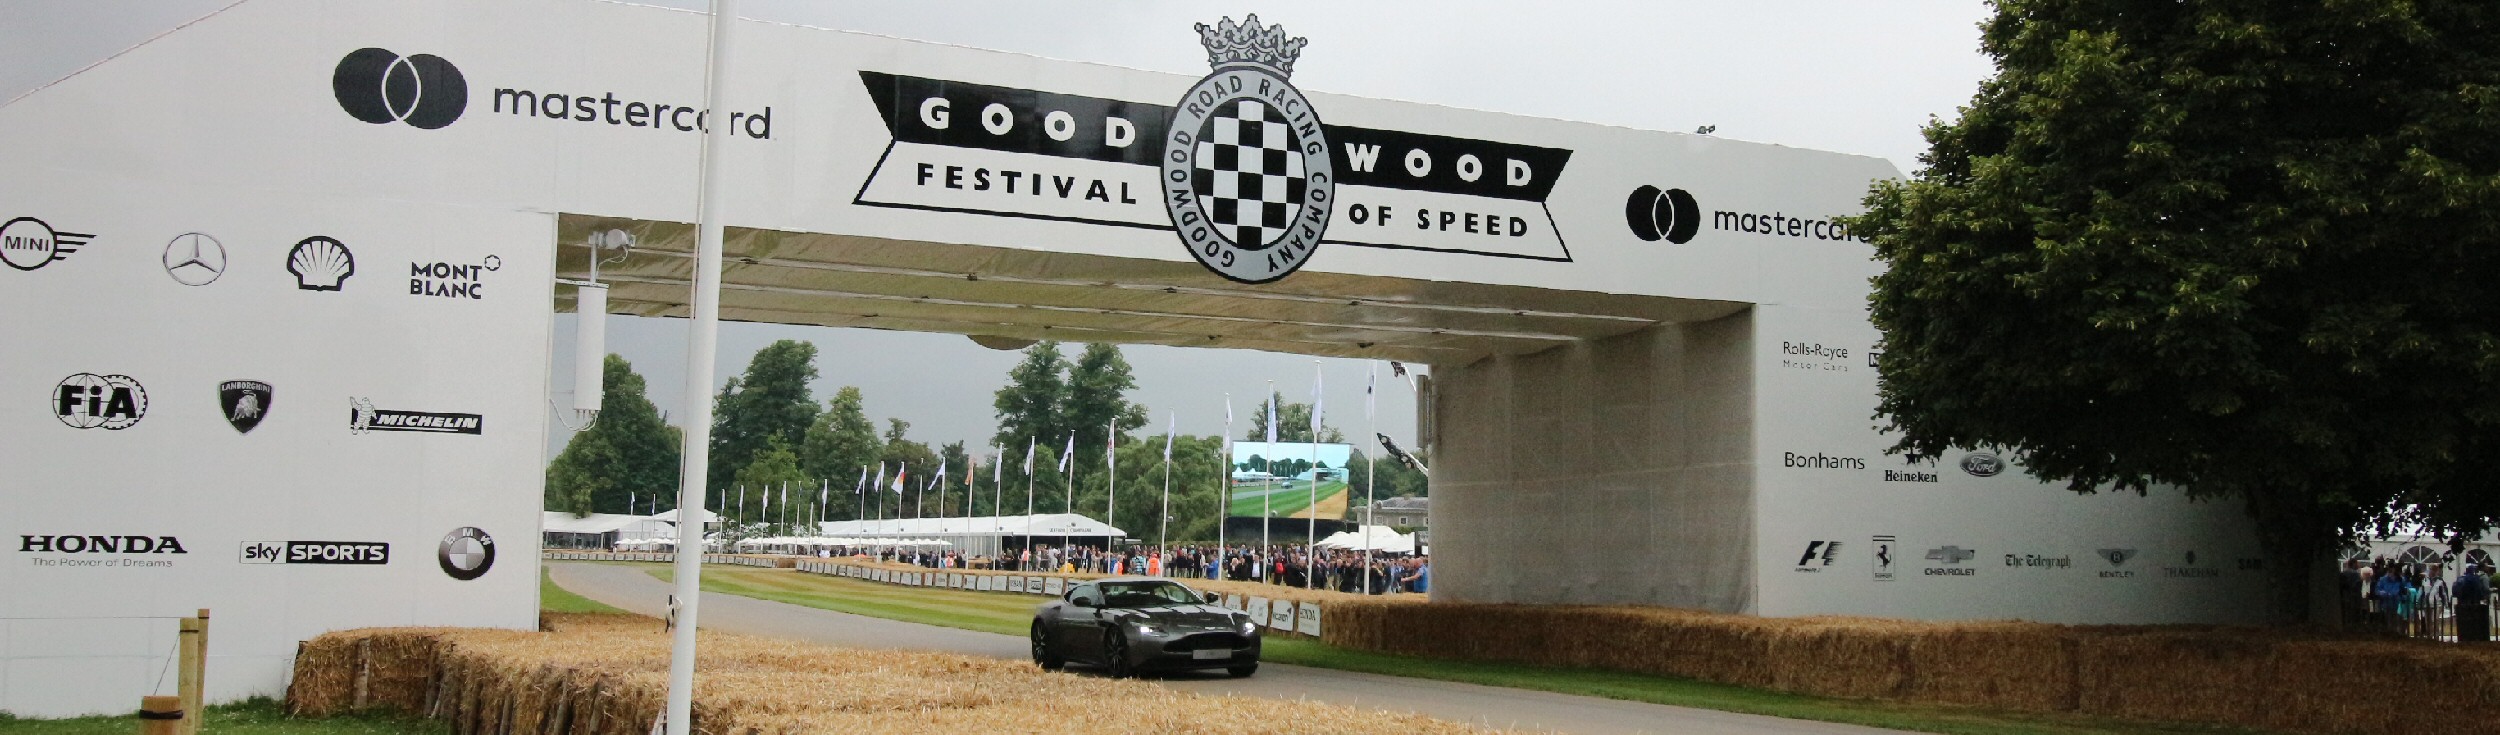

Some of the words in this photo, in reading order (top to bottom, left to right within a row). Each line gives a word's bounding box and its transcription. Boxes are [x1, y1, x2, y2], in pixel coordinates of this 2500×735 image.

[1187, 75, 1243, 119] ROAD
[1259, 78, 1323, 156] RACING
[919, 96, 1136, 148] GOOD
[1344, 142, 1532, 187] WOOD
[917, 162, 1137, 205] FESTIVAL
[1348, 203, 1392, 227] OF
[1417, 208, 1528, 237] SPEED
[1170, 130, 1235, 268] GOODWOOD
[1268, 171, 1328, 273] COMPANY
[5, 235, 50, 252] MINI
[411, 261, 483, 282] MONT
[410, 278, 482, 300] BLANC
[1783, 341, 1848, 360] Rolls-Royce
[221, 382, 272, 393] LAMBORGHINI
[377, 414, 478, 429] MICHELIN
[1784, 451, 1866, 470] Bonhams
[1968, 456, 1998, 473] Ford
[1884, 469, 1938, 483] Heineken
[18, 534, 188, 554] HONDA
[245, 542, 282, 563] sky
[290, 544, 386, 561] SPORTS
[32, 557, 56, 567] The
[60, 557, 102, 568] Power
[105, 558, 119, 567] of
[123, 558, 173, 568] Dreams
[2004, 553, 2023, 568] The
[1924, 568, 1975, 576] CHEVROLET
